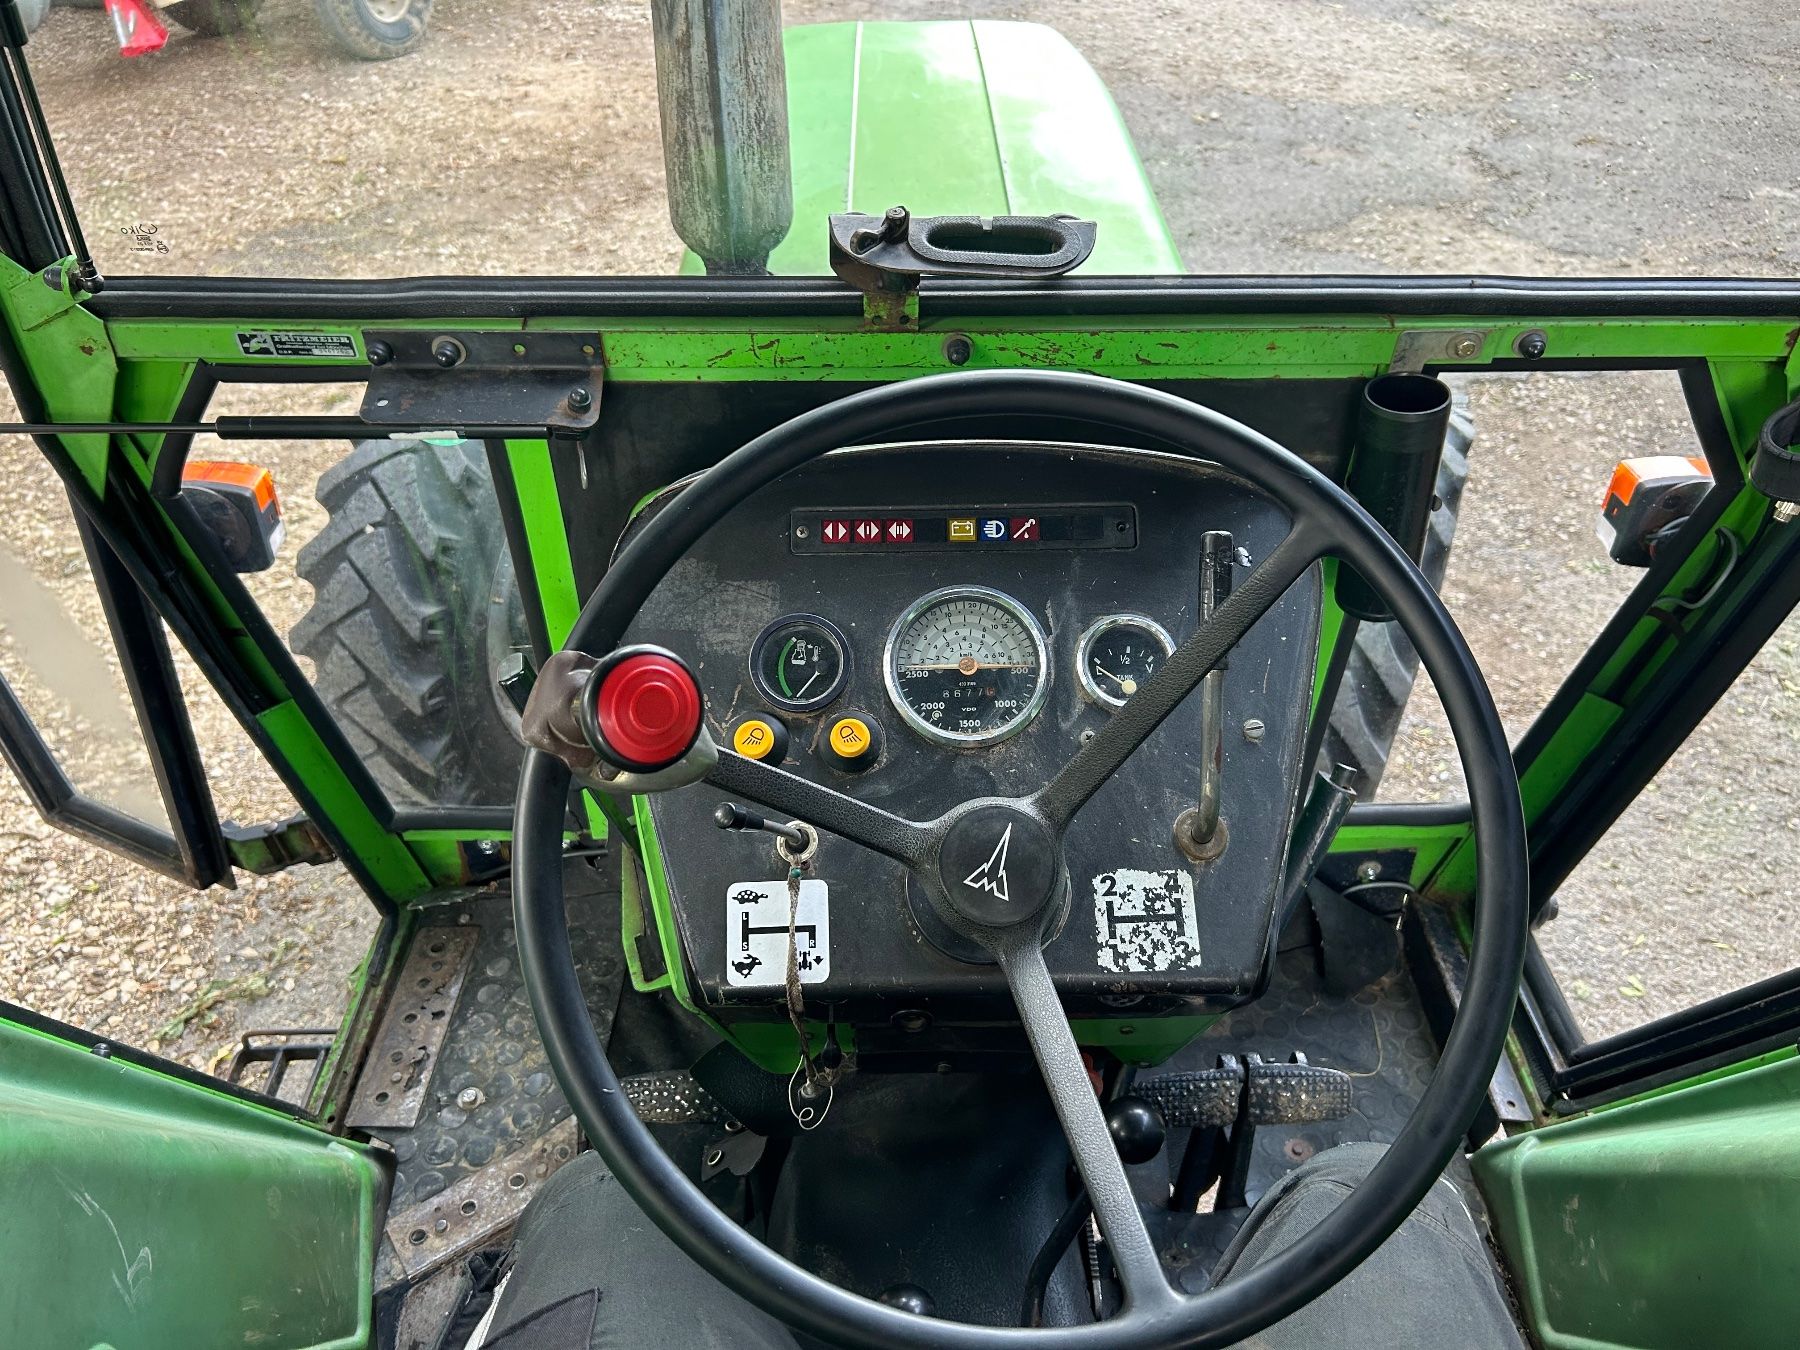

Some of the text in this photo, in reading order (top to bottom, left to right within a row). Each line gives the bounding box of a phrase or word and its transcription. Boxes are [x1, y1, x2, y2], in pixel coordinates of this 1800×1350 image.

[1120, 654, 1130, 664] 1/2
[1145, 664, 1153, 673] V
[920, 702, 944, 710] 2000
[959, 720, 980, 728] 1500
[1100, 875, 1118, 896] 2
[1164, 873, 1181, 894] 4
